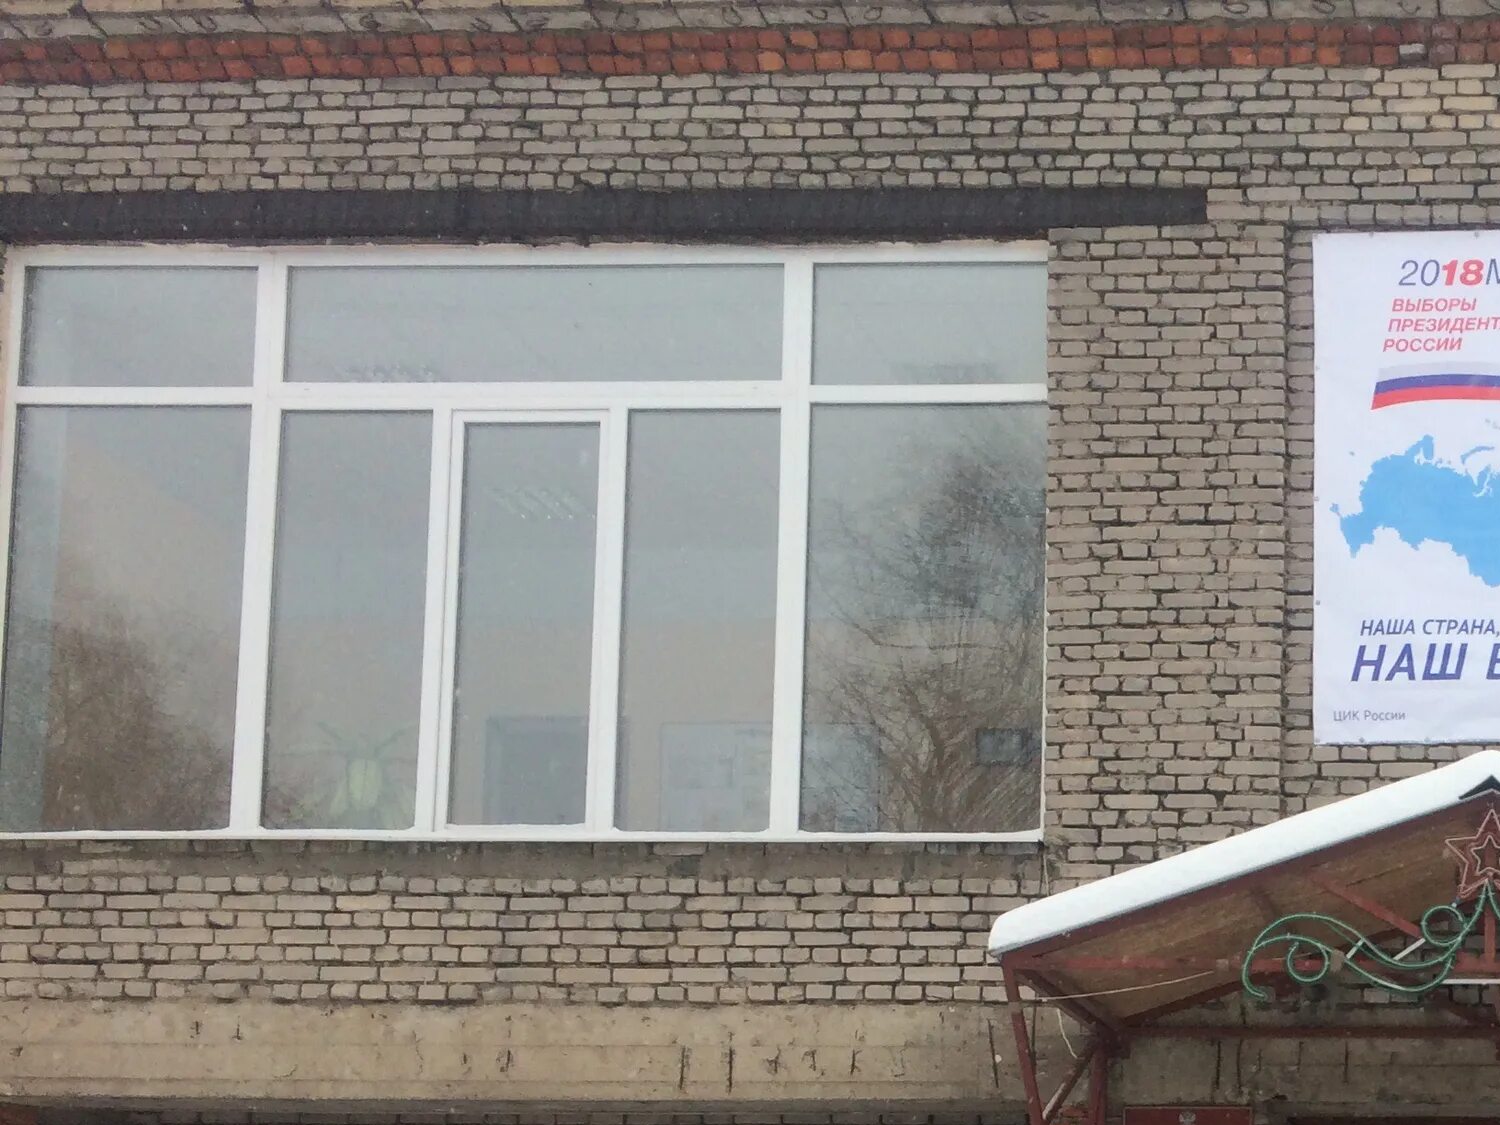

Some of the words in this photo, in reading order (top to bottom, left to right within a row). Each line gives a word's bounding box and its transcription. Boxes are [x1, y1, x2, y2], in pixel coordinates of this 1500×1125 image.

[1391, 298, 1477, 313] ВЫБОРЫ
[1382, 337, 1463, 352] РОССИИ
[1360, 619, 1415, 636] НАША
[1422, 619, 1500, 638] СТРАНА,
[1350, 642, 1468, 682] НАШ
[1333, 710, 1360, 723] ЦИК
[1363, 709, 1406, 722] России
